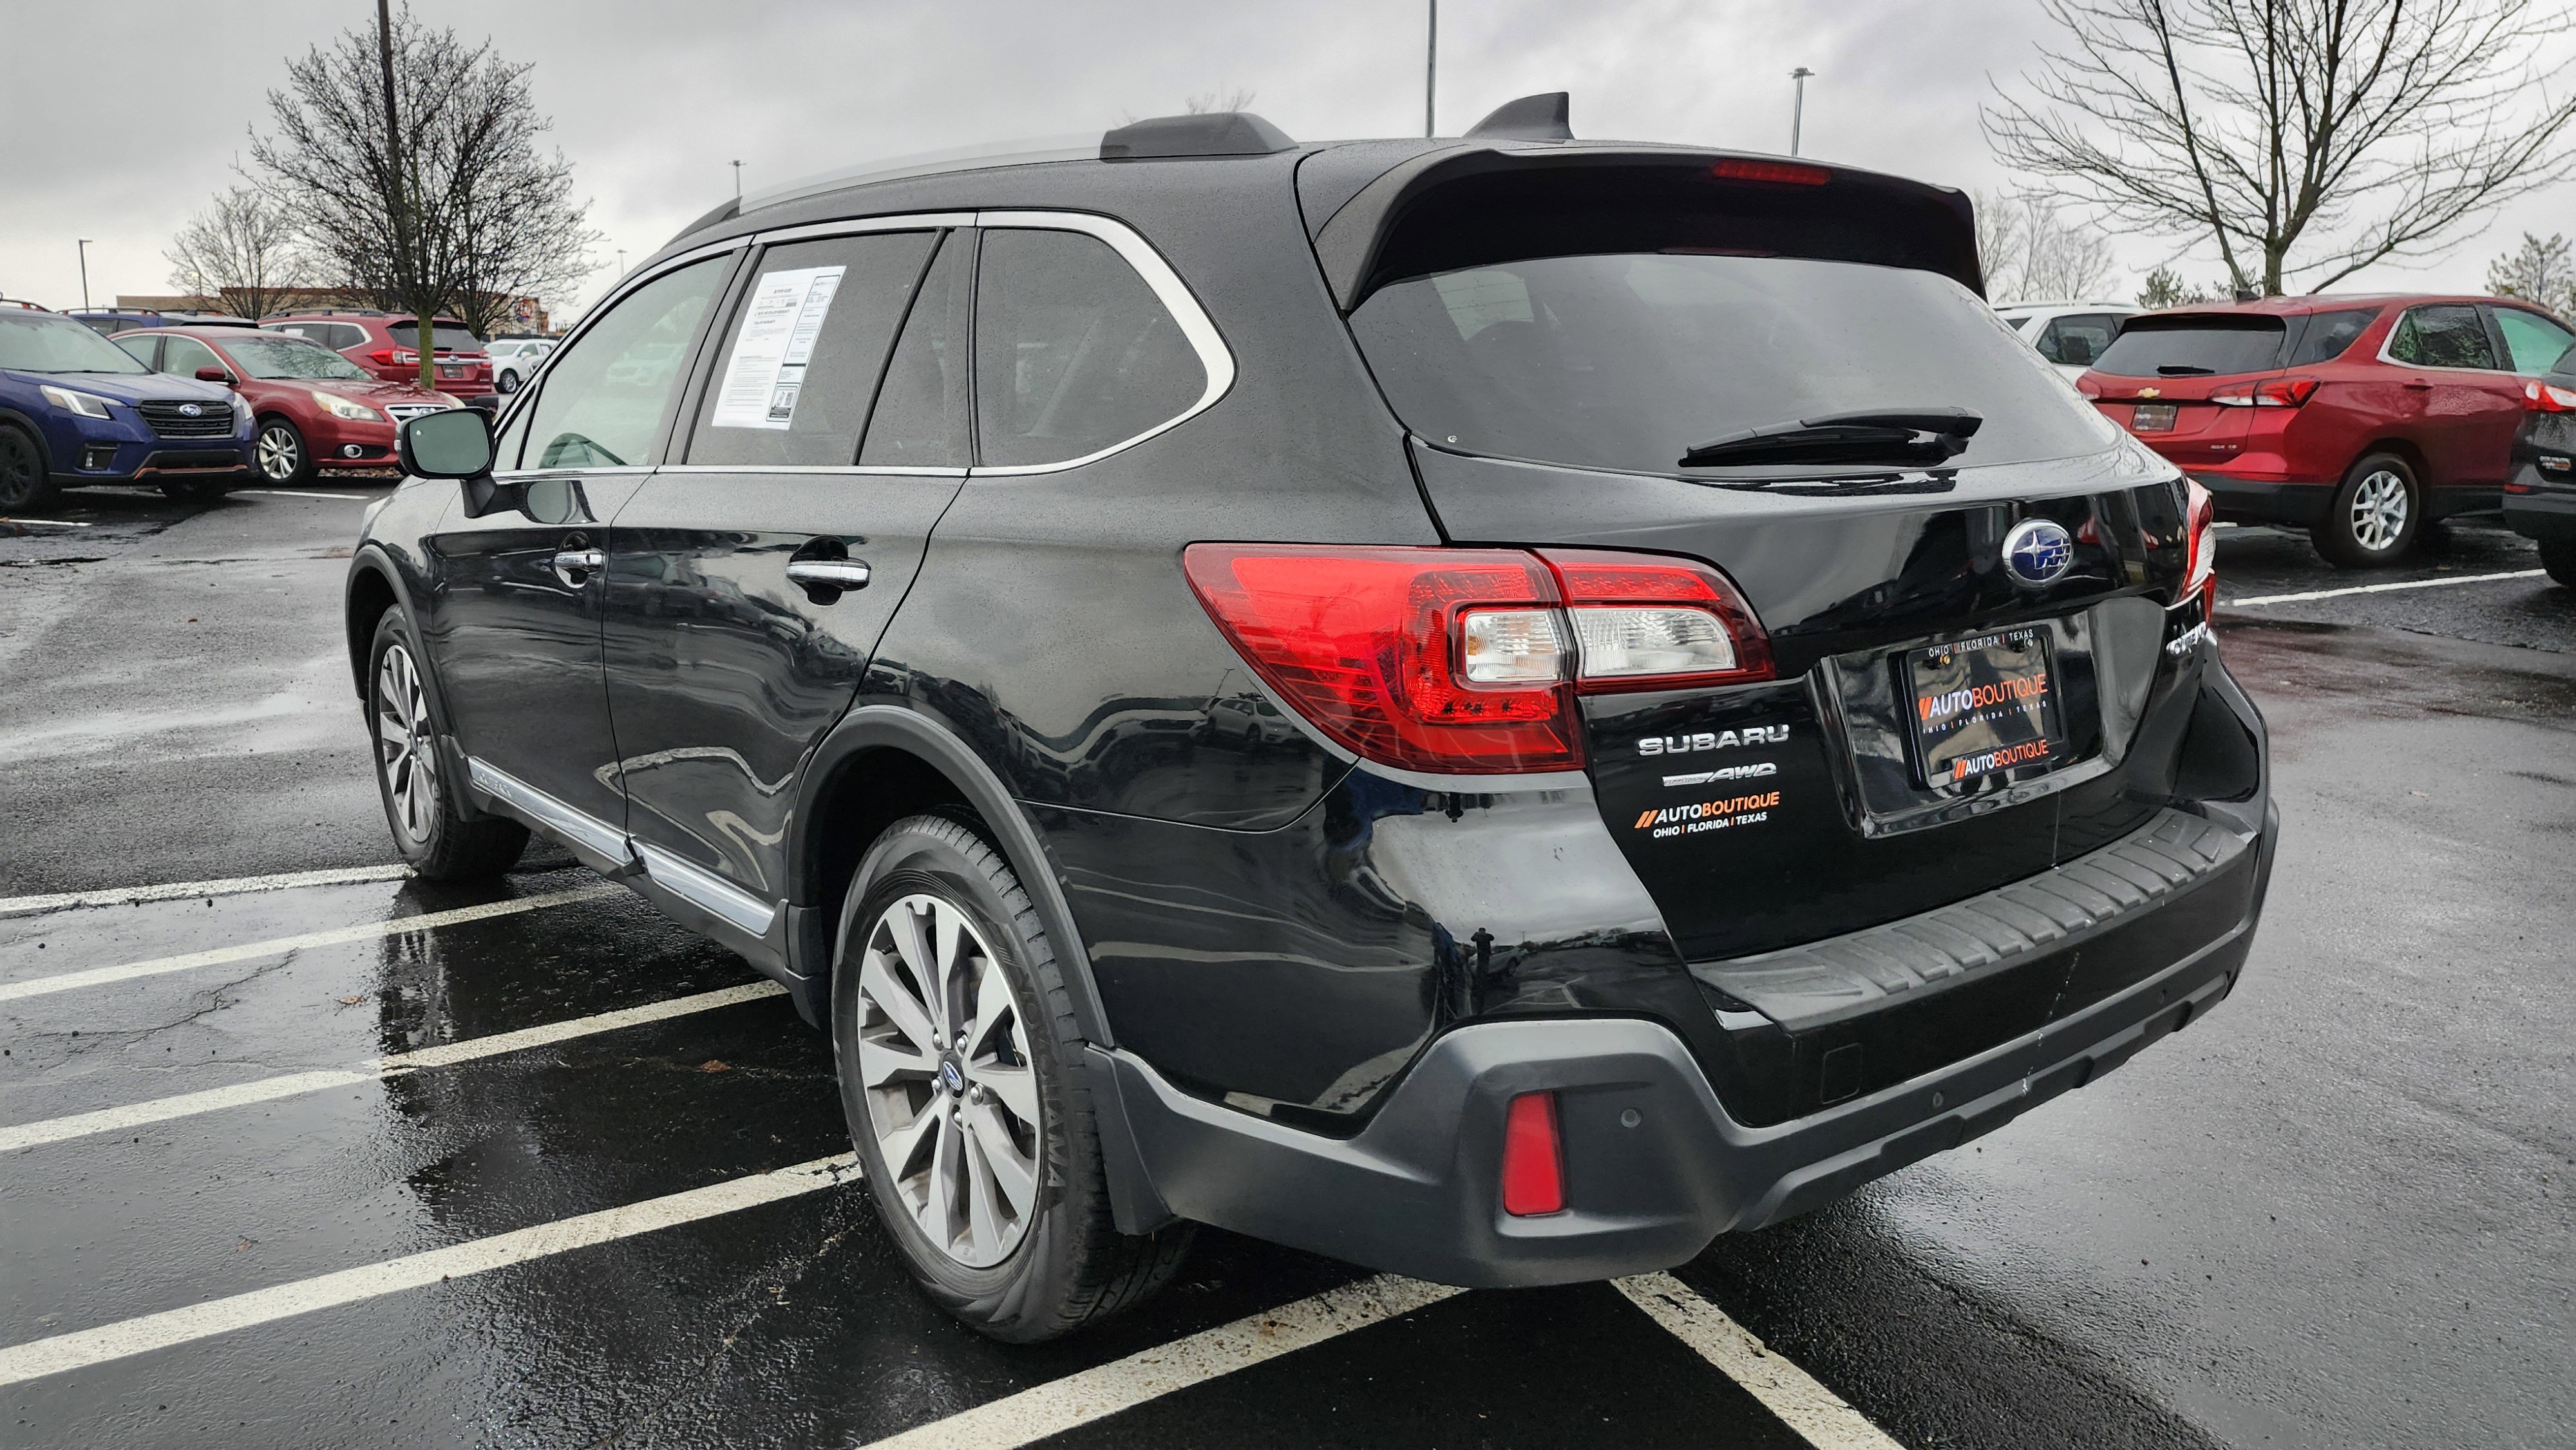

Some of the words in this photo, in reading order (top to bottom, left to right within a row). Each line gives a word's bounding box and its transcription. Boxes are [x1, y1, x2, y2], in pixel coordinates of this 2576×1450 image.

[1928, 645, 1949, 657] OHIO
[1960, 636, 1998, 652] FLORIDA
[2008, 628, 2034, 642] TEXAS
[1929, 673, 2049, 718] AUTOBOUTIQUE
[1958, 710, 2003, 726] FLORIDA
[2016, 700, 2047, 713] TEXAS
[1638, 724, 1790, 757] SUBARU
[1707, 762, 1777, 783] AWD
[1964, 739, 2049, 777] AUTOBOUTIQUE
[1654, 791, 1780, 824] AUTOBOUTIQUE
[1653, 825, 1680, 838] OHIO
[1687, 818, 1730, 834] FLORIDA
[1736, 811, 1768, 825] TEXAS
